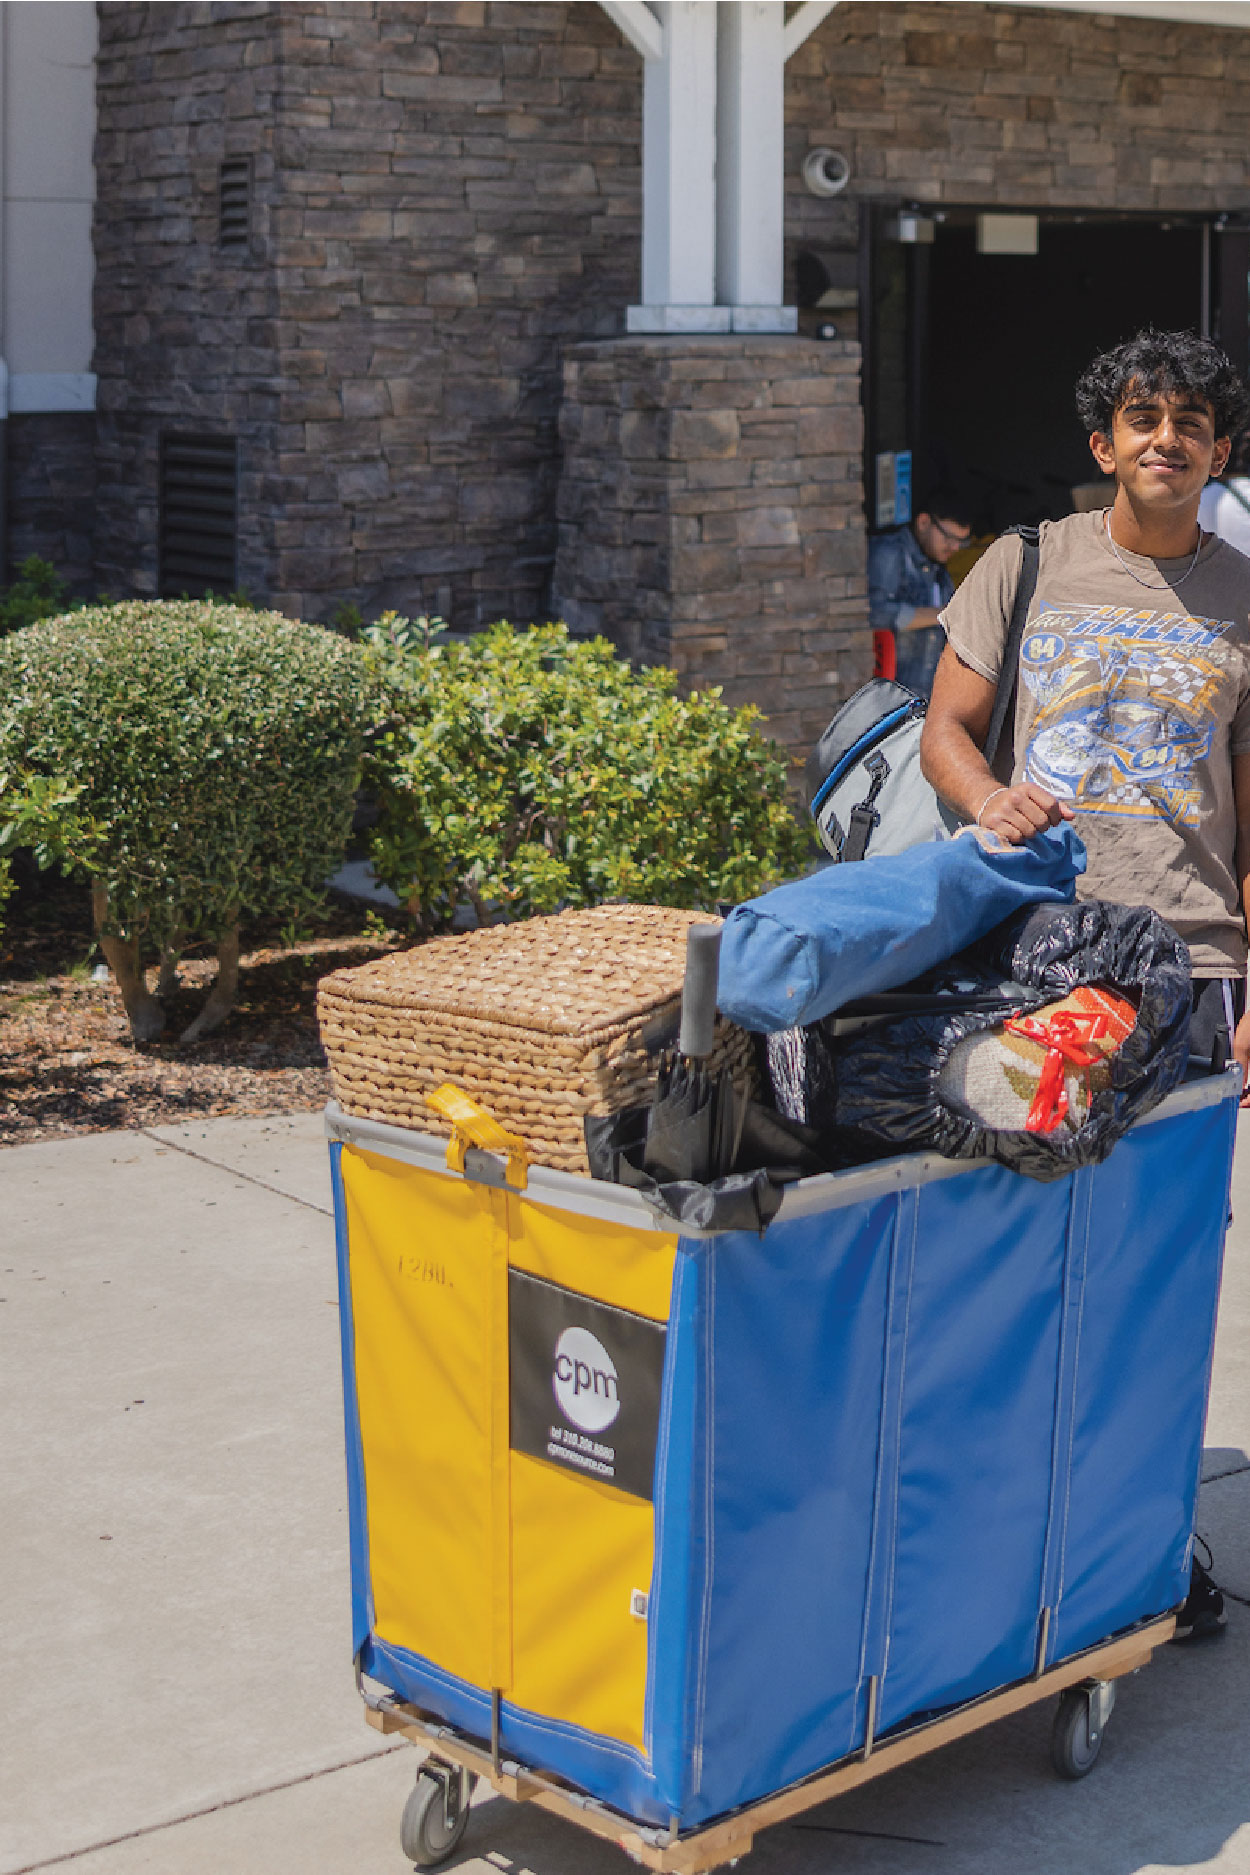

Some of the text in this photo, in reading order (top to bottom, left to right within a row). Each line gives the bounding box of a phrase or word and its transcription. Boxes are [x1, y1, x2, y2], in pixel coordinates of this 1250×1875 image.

[1067, 606, 1235, 646] HALEN
[1029, 637, 1056, 659] 84
[1139, 746, 1168, 767] 84
[555, 1353, 620, 1398] cpm
[550, 1425, 562, 1440] tel
